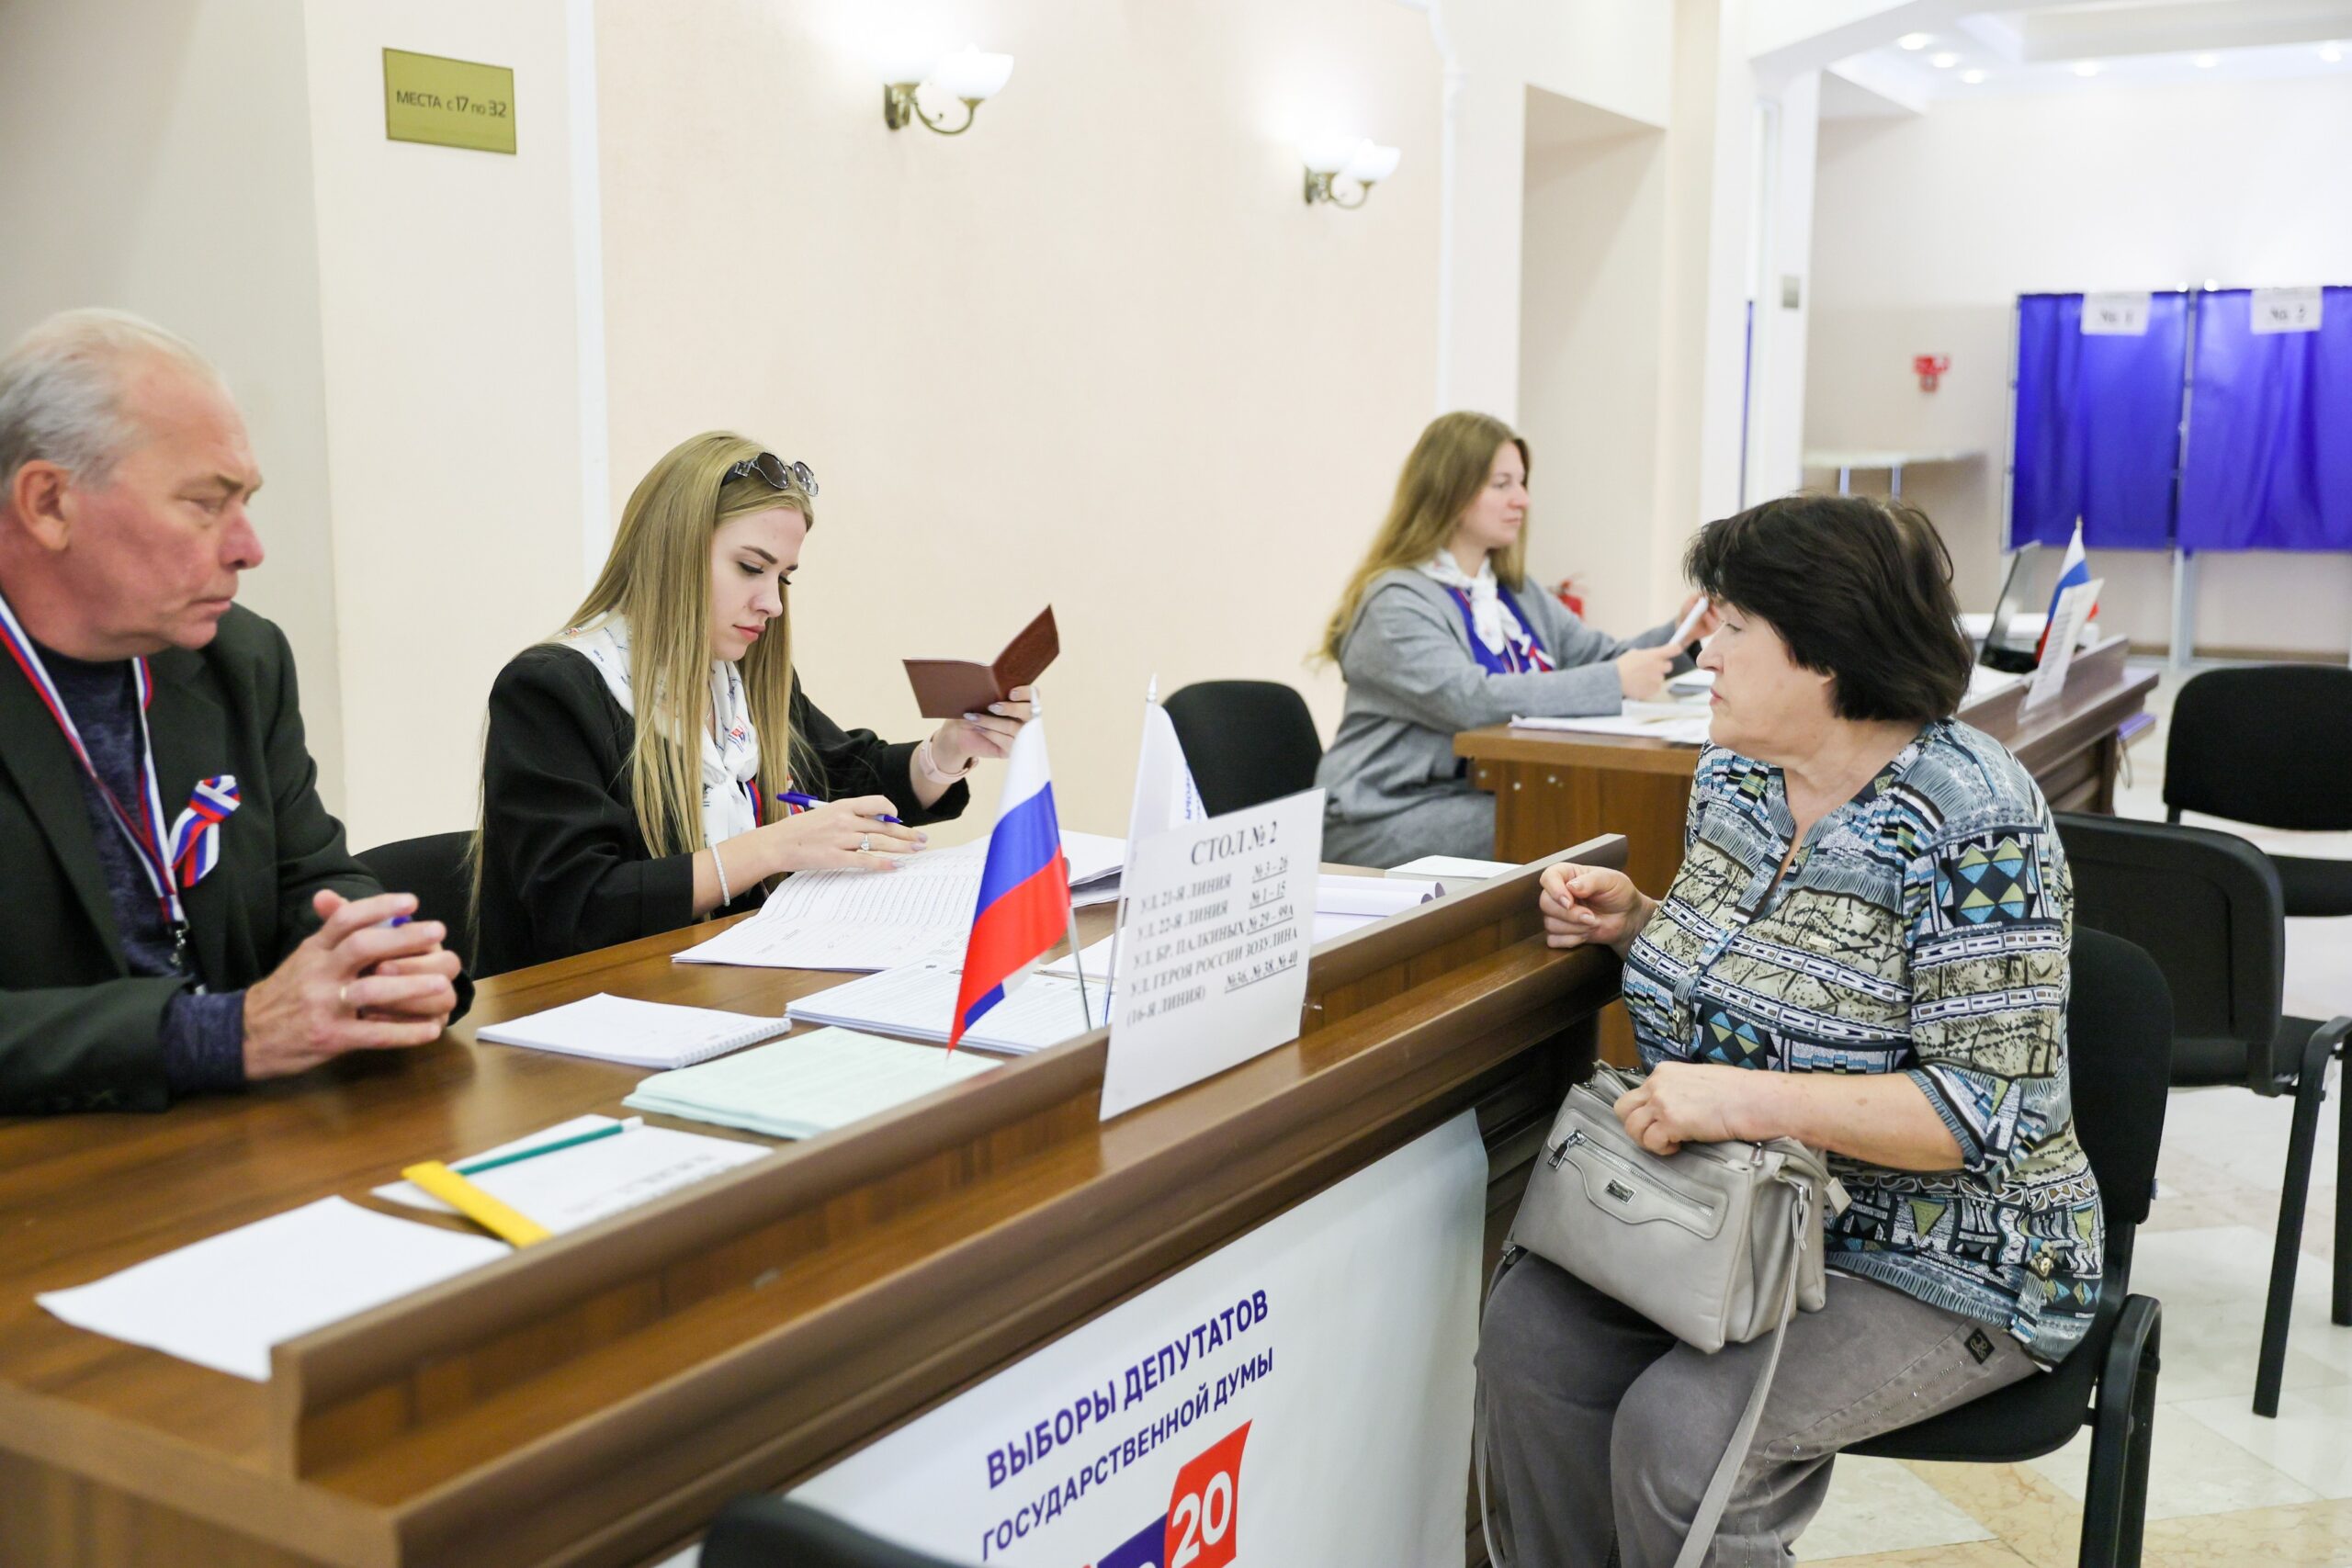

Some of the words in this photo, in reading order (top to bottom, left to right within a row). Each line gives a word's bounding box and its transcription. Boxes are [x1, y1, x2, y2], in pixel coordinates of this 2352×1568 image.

[397, 90, 442, 108] МЕСТА
[456, 96, 469, 112] 17
[471, 103, 486, 116] по
[489, 100, 507, 118] 32
[1191, 829, 1245, 865] СТОЛ
[1248, 825, 1266, 851] №
[1270, 820, 1278, 844] 2
[1161, 886, 1185, 908] 21-Я
[1187, 874, 1232, 899] ЛИНИЯ
[1159, 913, 1182, 934] 22-Я
[1184, 899, 1228, 927] ЛИНИЯ
[1176, 919, 1245, 956] ПАЛКИНЫХ
[1153, 963, 1193, 990] ГЕРОЯ
[1195, 946, 1243, 975] РОССИИ
[1245, 927, 1297, 957] ЗОЗУЛИНА
[1158, 985, 1206, 1012] ЛИНИЯ)
[986, 1381, 1116, 1490] ВЫБОРЫ
[1124, 1289, 1269, 1410] ДЕПУТАТОВ
[982, 1382, 1209, 1562] ГОСУДАРСТВЕННОЙ
[1214, 1347, 1273, 1412] ДУМЫ
[1171, 1471, 1233, 1568] 20
